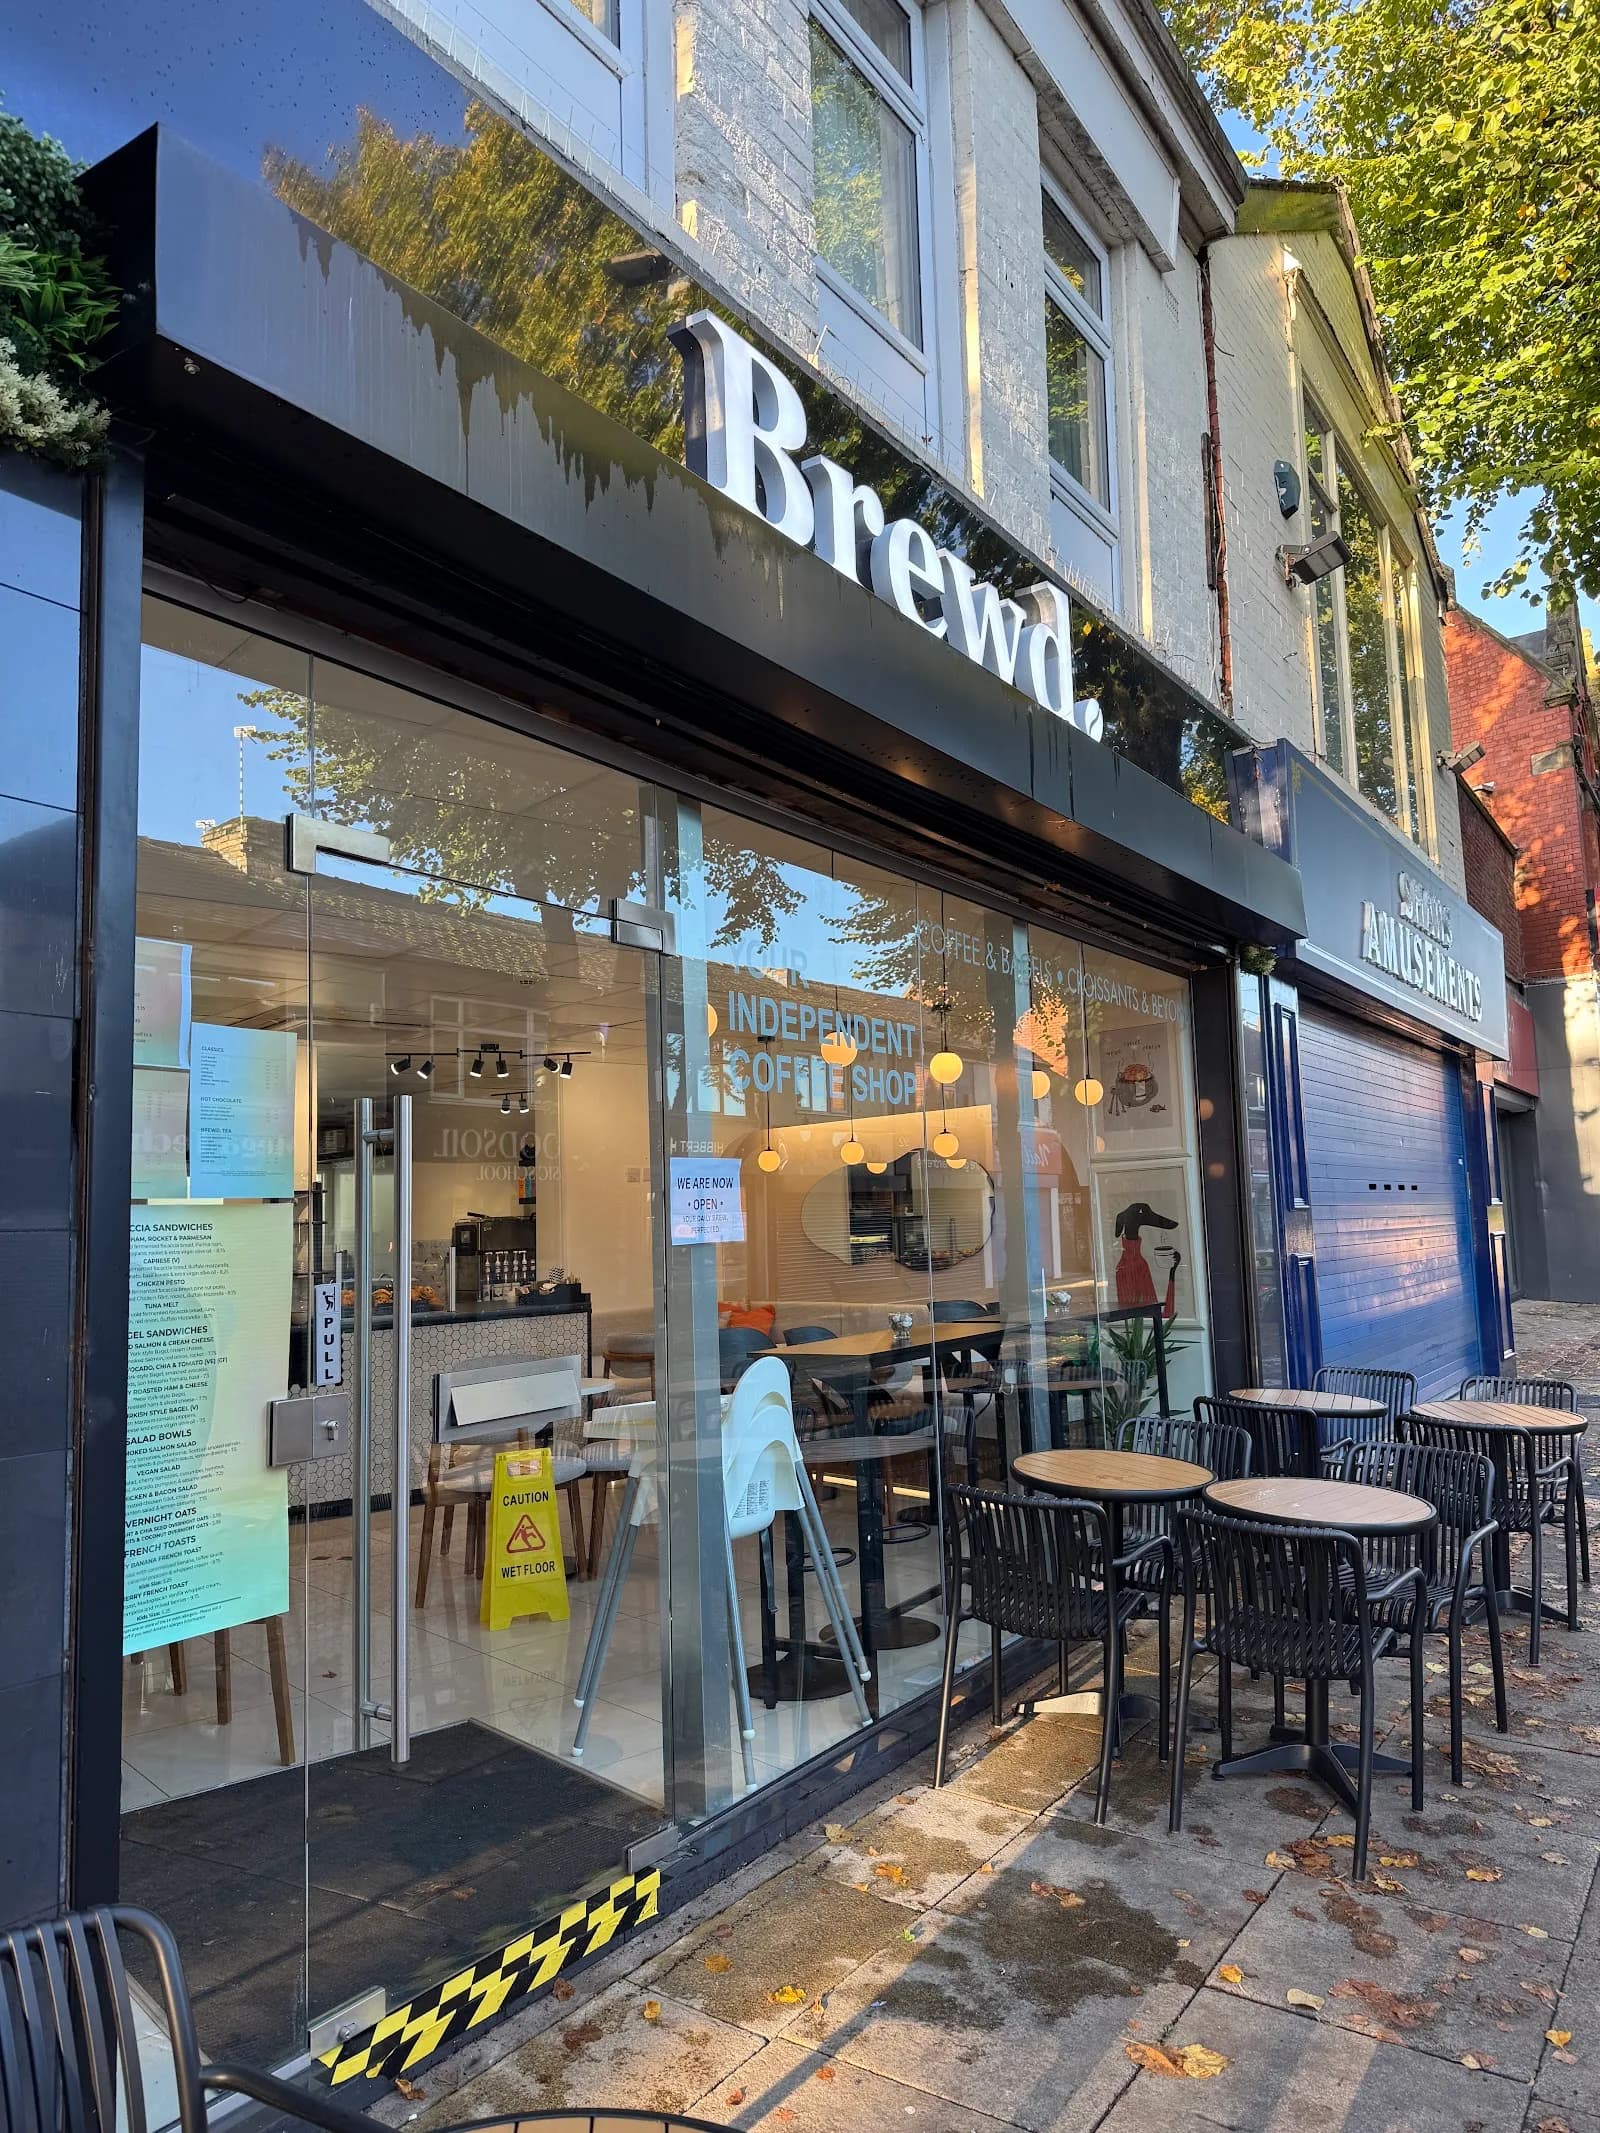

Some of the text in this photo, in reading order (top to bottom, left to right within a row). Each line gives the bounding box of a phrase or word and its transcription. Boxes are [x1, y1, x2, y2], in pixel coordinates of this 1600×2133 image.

[668, 308, 1104, 743] Brewd.
[731, 940, 811, 990] YOUR
[917, 920, 981, 966] COFFEE
[985, 941, 997, 971] &
[1001, 948, 1053, 985] BAGELS
[1067, 968, 1139, 1008] CROISSANTS
[1141, 990, 1150, 1013] &
[1360, 899, 1482, 1022] AMUSEMENTS
[728, 991, 916, 1058] INDEPENDENT
[729, 1047, 916, 1106] COFFE SHOP
[677, 1177, 734, 1189] WE ARE NOW
[693, 1199, 717, 1210] OPEN
[153, 1223, 213, 1231] SANDWICHES
[128, 1326, 208, 1340] GEL SANDWICHES
[323, 1317, 335, 1380] PULL
[178, 1360, 204, 1368] TOMATO
[134, 1387, 163, 1395] ROASTED
[126, 1430, 192, 1446] SALAD BOWLS
[148, 1444, 175, 1453] SALMON
[176, 1441, 197, 1449] SALAD
[136, 1464, 181, 1477] VEGAN SALAD
[154, 1488, 177, 1497] BACON
[178, 1484, 198, 1493] SALAD
[503, 1490, 549, 1507] CAUTION
[125, 1508, 197, 1529] VERNIGHT OATS
[154, 1524, 167, 1532] SEED
[168, 1518, 195, 1529] OVERNIGHT
[140, 1532, 167, 1541] COCONUT
[168, 1526, 195, 1536] OVERNIGHT
[124, 1536, 196, 1558] FRENCH TOASTS
[130, 1558, 157, 1569] BANANA
[158, 1552, 183, 1561] FRENCH
[184, 1546, 202, 1555] TOAST
[501, 1560, 556, 1579] WET FLOOR
[142, 1586, 168, 1597] FRENCH
[169, 1581, 189, 1591] TOAST
